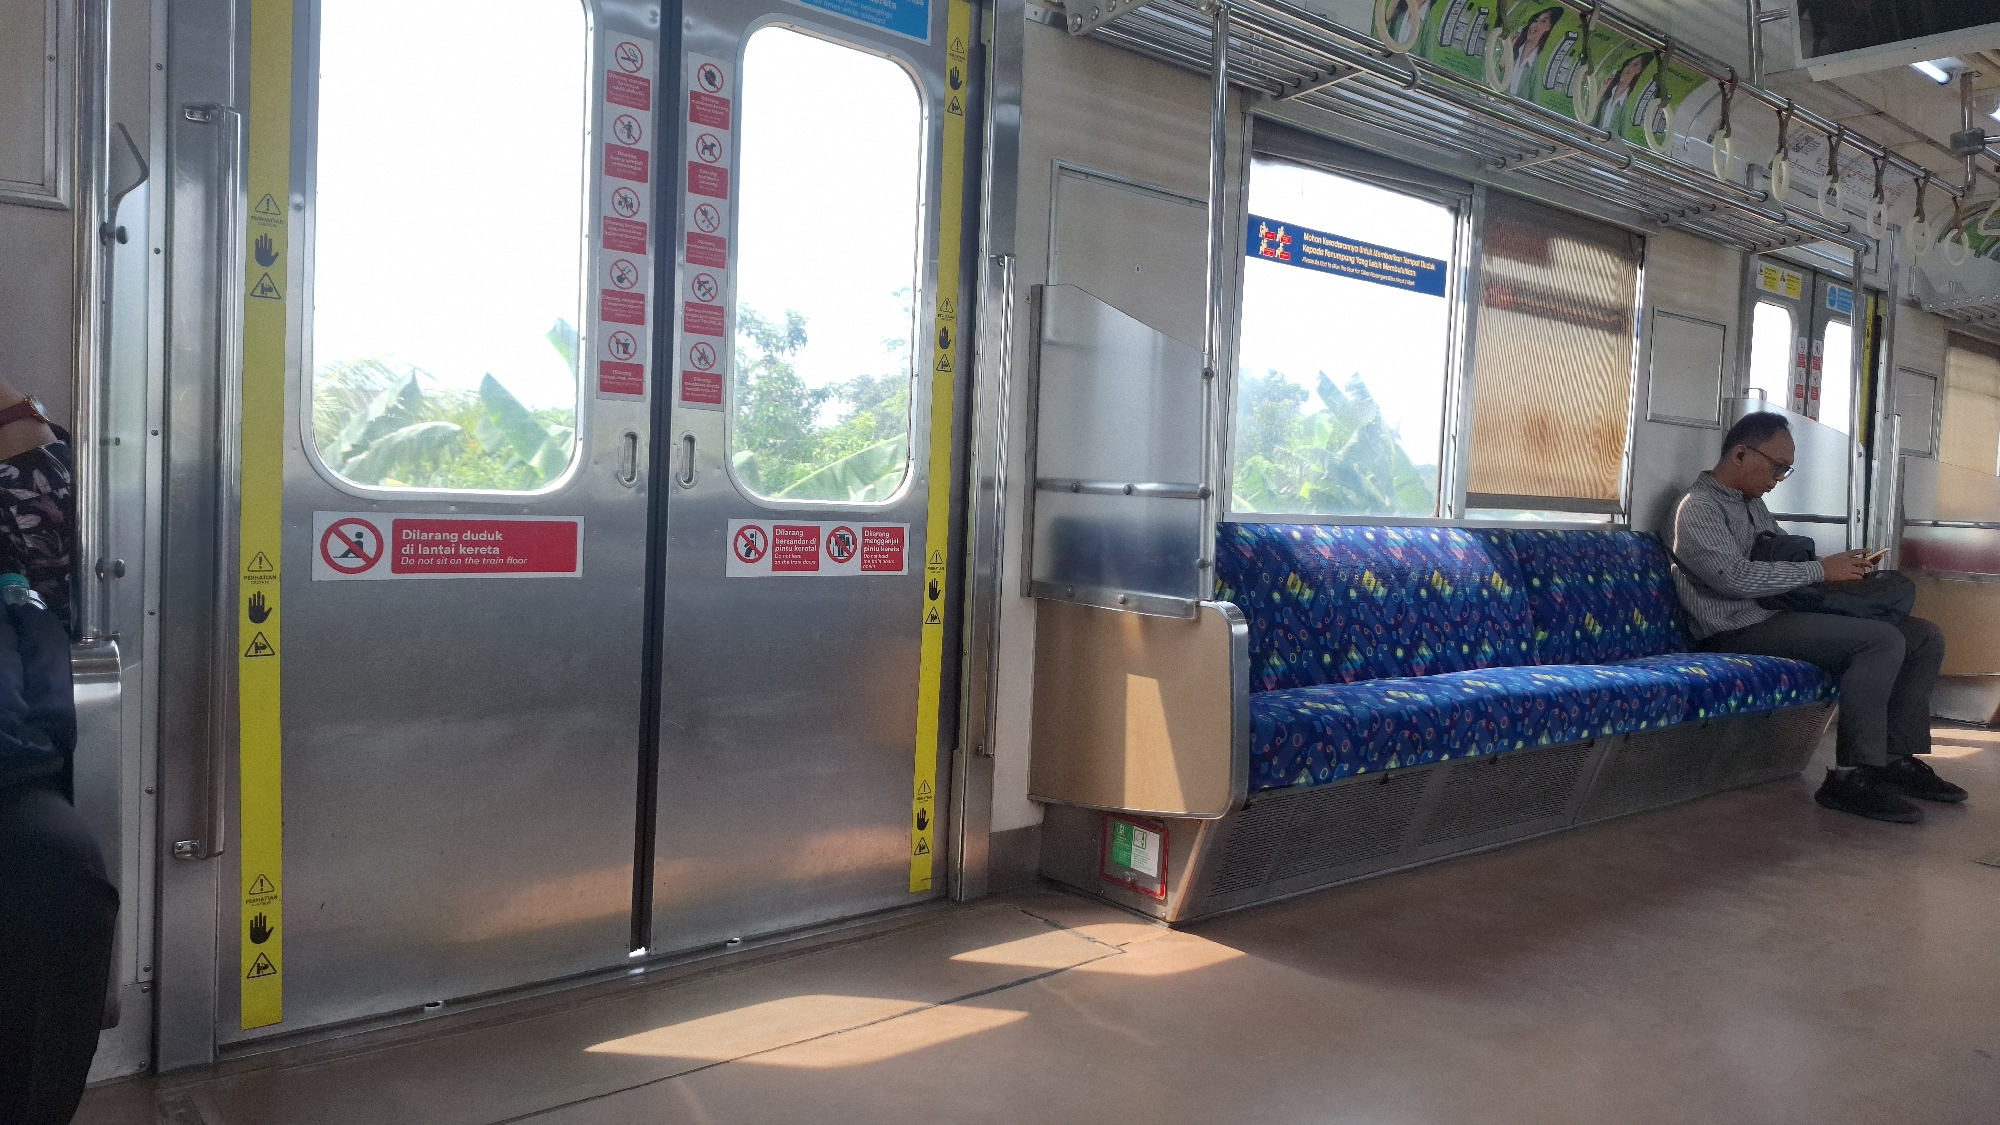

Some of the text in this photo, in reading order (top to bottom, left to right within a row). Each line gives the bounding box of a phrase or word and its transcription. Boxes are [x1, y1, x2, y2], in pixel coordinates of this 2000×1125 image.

[842, 7, 858, 16] while
[860, 12, 886, 24] onboard
[861, 3, 893, 18] belongings
[1303, 244, 1324, 255] Kepada
[1325, 249, 1355, 264] Penumpang
[1356, 256, 1368, 267] Yang
[1369, 259, 1382, 269] Lebih
[1304, 232, 1322, 244] Mohon
[1359, 246, 1372, 255] Untuk
[1373, 249, 1402, 263] Memberikan
[1403, 256, 1420, 267] Tempat
[1421, 260, 1435, 270] Duduk
[402, 529, 503, 543] Dilarang duduk
[775, 529, 804, 537] Dilarang
[864, 530, 890, 538] Dilarang
[401, 543, 500, 555] di lantai kereta
[863, 545, 880, 553] pintu
[401, 556, 415, 565] Do
[418, 556, 434, 565] not
[436, 556, 448, 565] sit
[465, 556, 480, 565] the
[482, 556, 504, 565] train
[506, 556, 527, 565] floor
